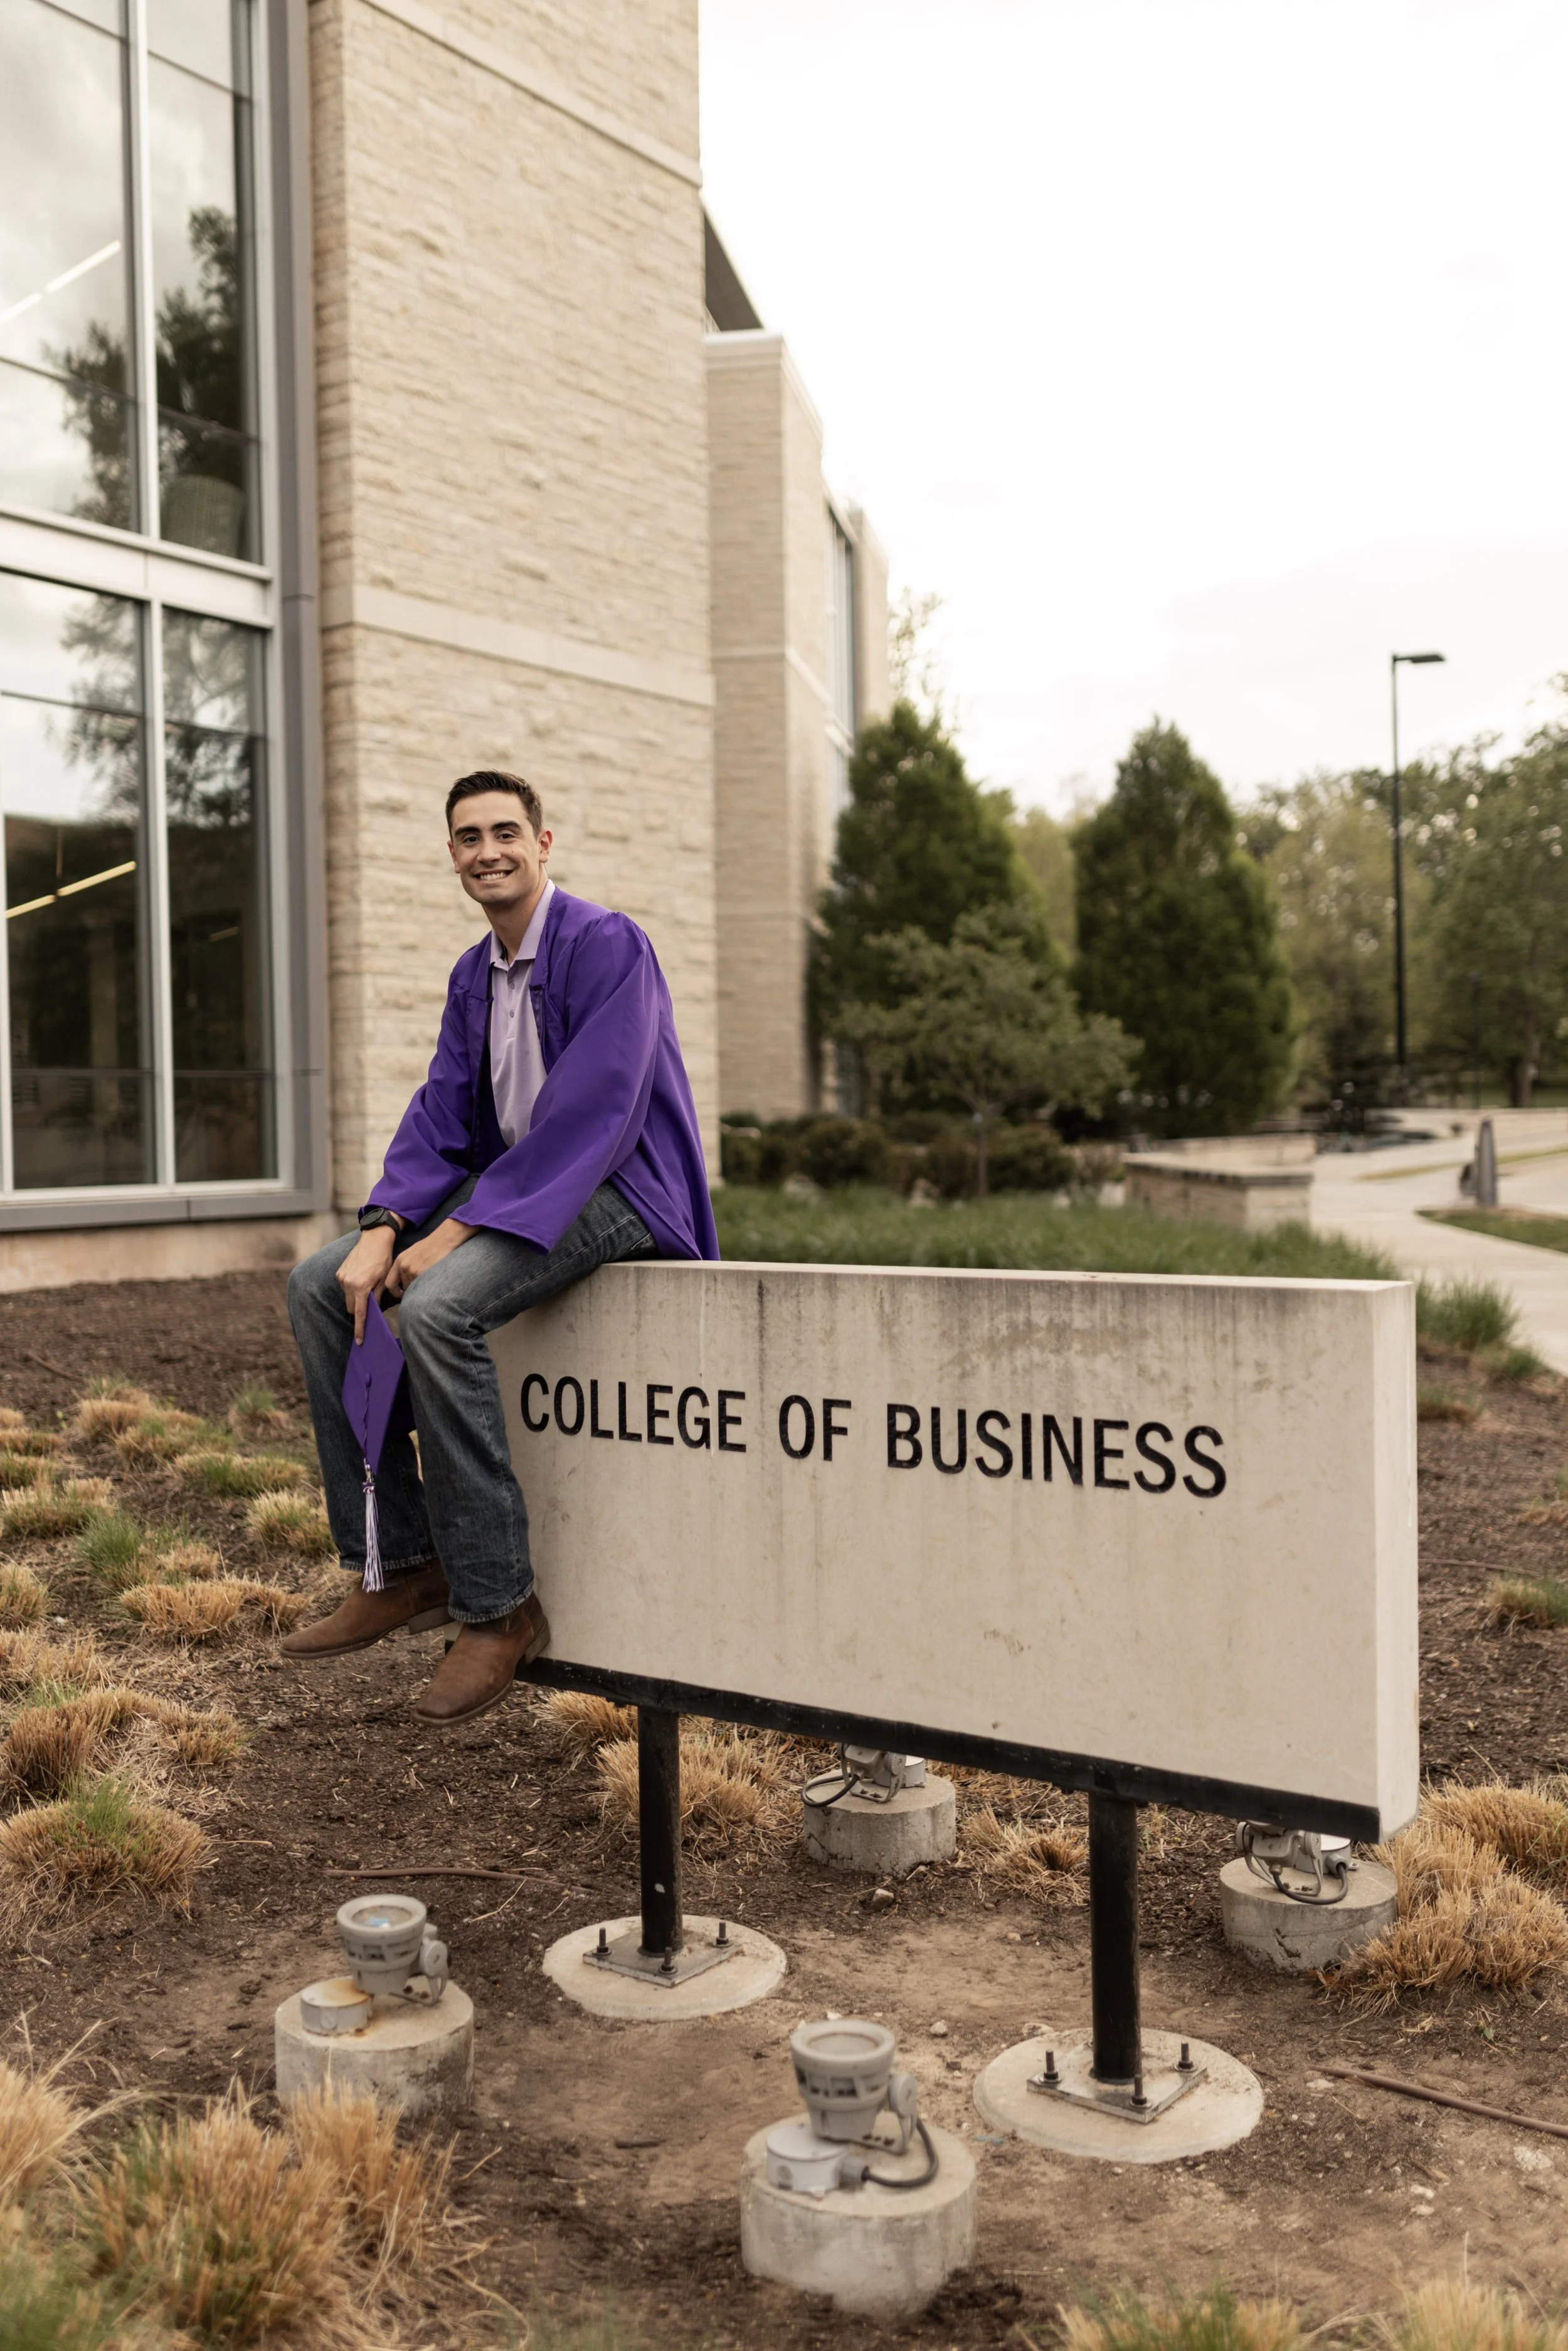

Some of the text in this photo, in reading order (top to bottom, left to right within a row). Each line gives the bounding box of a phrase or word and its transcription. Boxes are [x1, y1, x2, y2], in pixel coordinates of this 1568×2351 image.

[519, 1373, 1227, 1499] COLLEGE OF BUSINESS
